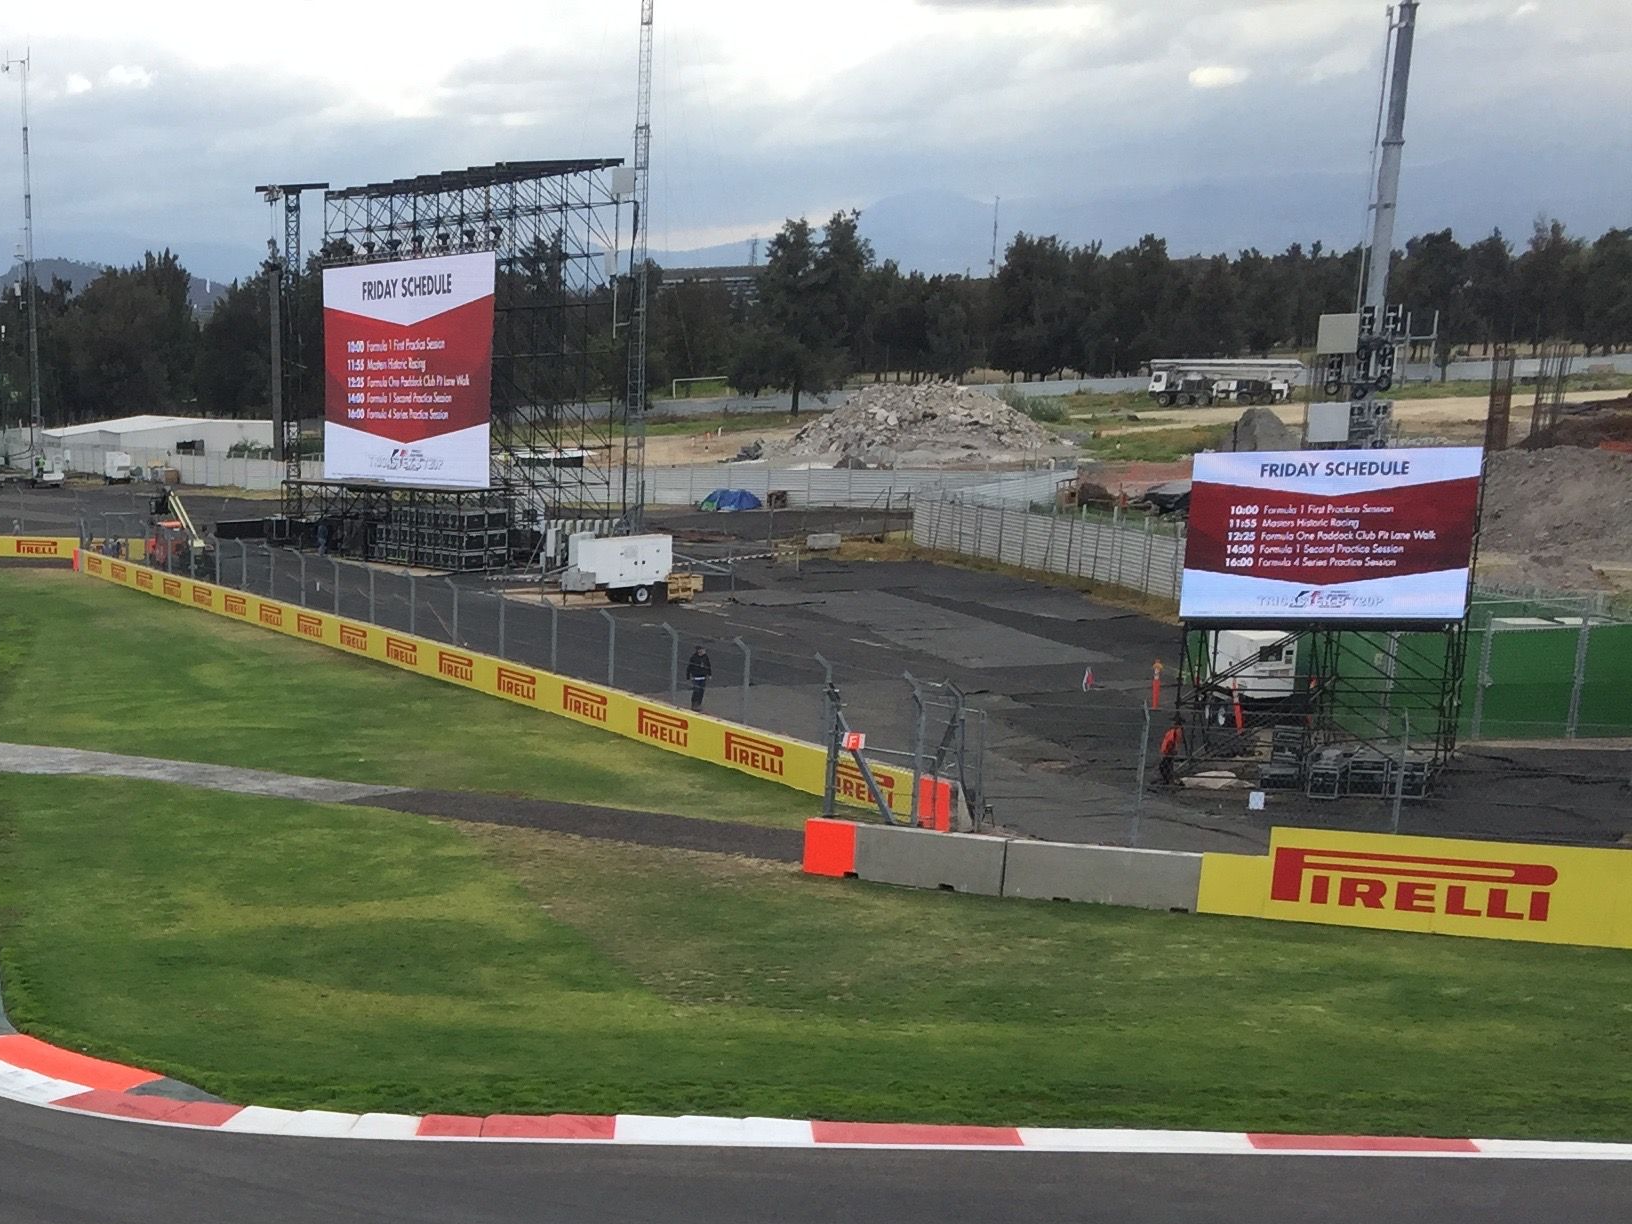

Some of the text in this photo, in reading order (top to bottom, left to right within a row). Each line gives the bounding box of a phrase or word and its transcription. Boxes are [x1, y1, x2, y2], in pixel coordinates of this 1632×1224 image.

[362, 273, 452, 301] FRIDAY SCHEDULE
[366, 340, 387, 352] Formula
[393, 339, 405, 351] First
[347, 358, 365, 371] 11:55
[367, 376, 387, 388] Formula
[388, 376, 399, 387] One
[1260, 461, 1410, 477] FRIDAY SCHEDULE
[1230, 504, 1394, 515] 10:00 Formula 1 First Practice Session
[1227, 530, 1436, 541] 12:25 Formula One Paddock Club Pit Lane Walk
[1229, 518, 1360, 529] 11:55 Masters Historic Racing
[16, 539, 57, 554] PIRELLI
[1226, 543, 1404, 554] 14:00 Formula 1 Second Practice Session
[1225, 557, 1396, 567] 16:00 Formula 4 Series Practice Session
[259, 603, 282, 627] PIRELLI
[297, 613, 322, 638] PIRELLI
[340, 624, 367, 650] PIRELLI
[386, 637, 417, 665] PIRELLI
[438, 651, 473, 682] PIRELLI
[497, 666, 536, 700] PIRELLI
[563, 684, 608, 722] PIRELLI
[638, 707, 688, 747] PIRELLI
[725, 731, 784, 776] PIRELLI
[835, 763, 895, 808] PIRELI
[1270, 847, 1558, 921] PIRELLI
